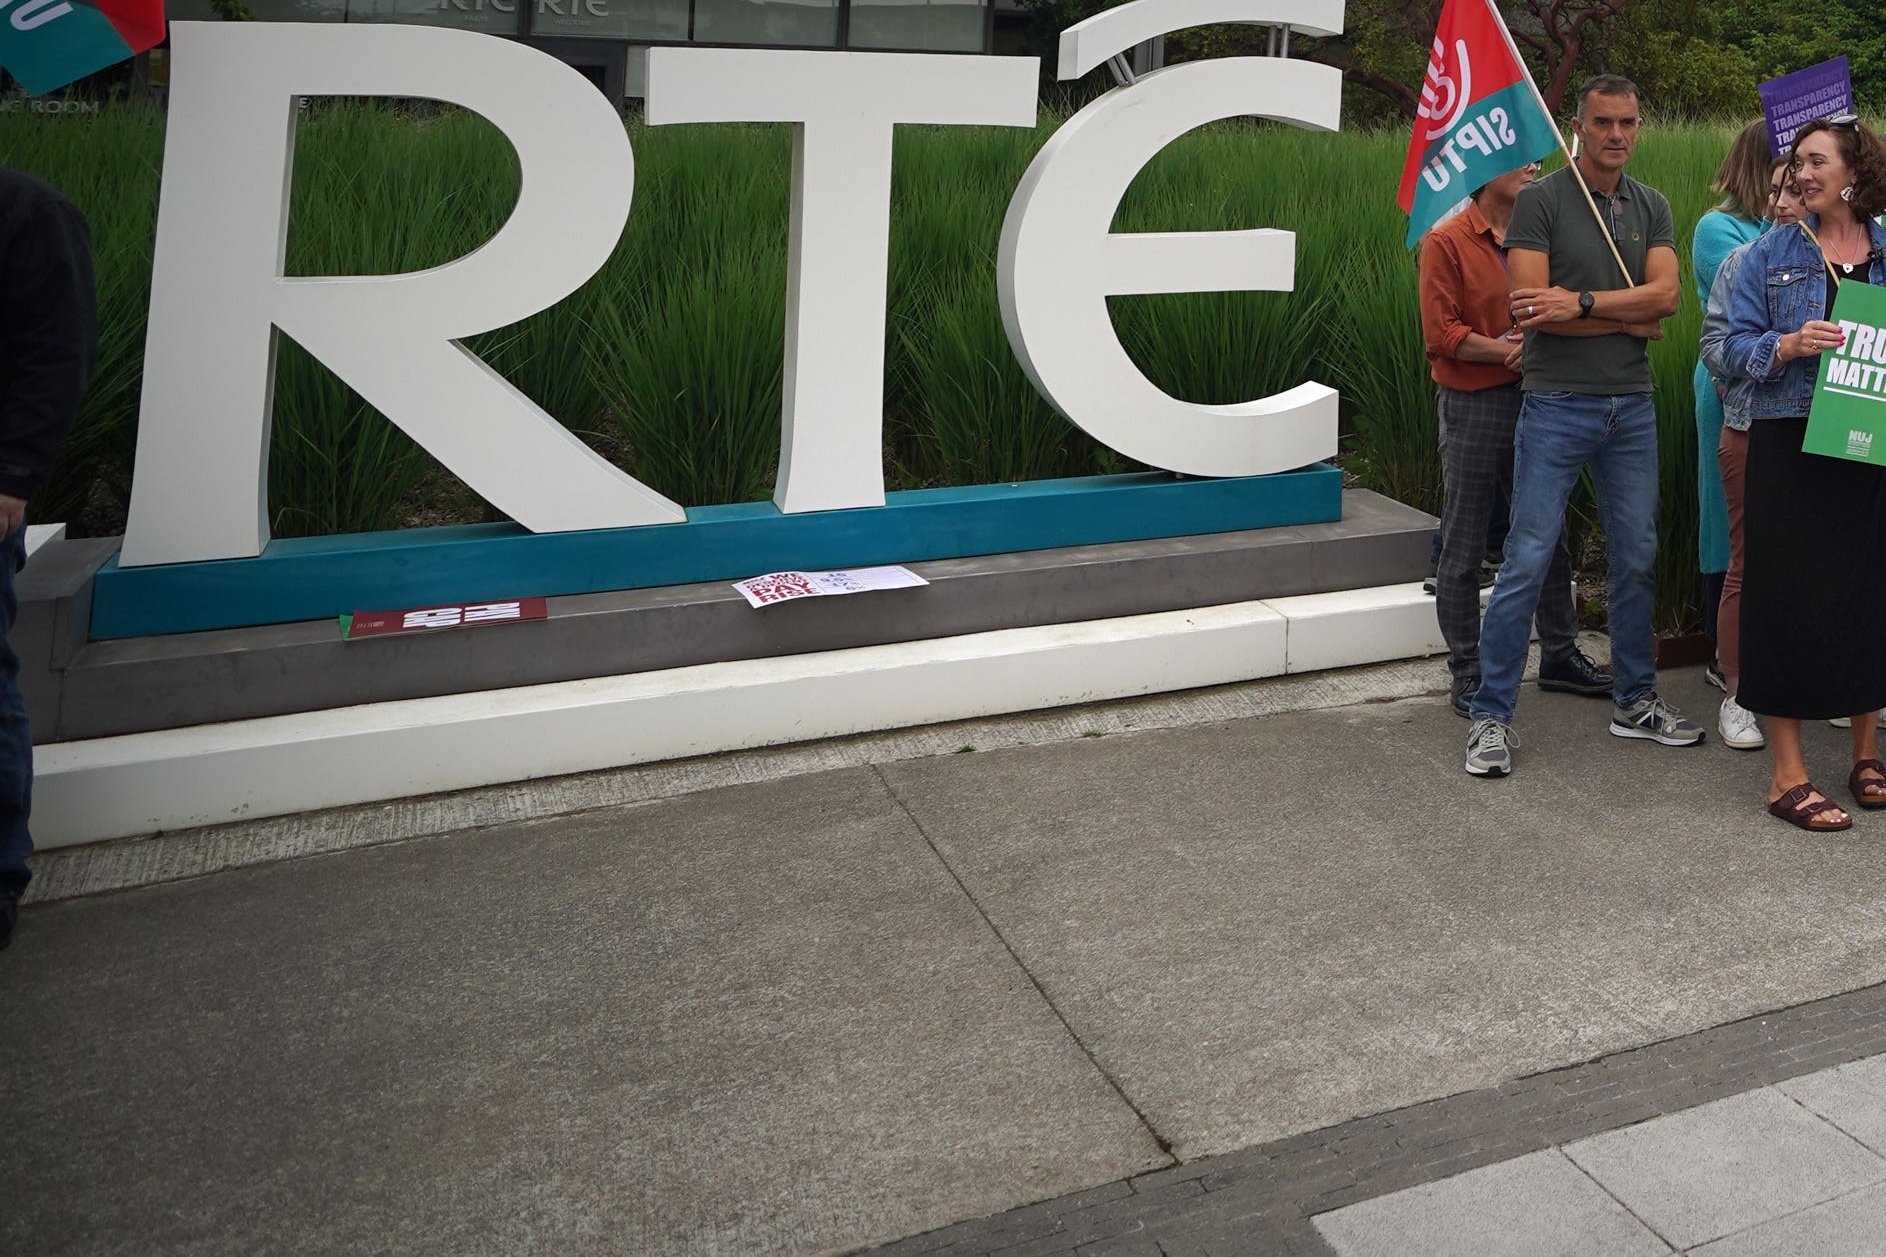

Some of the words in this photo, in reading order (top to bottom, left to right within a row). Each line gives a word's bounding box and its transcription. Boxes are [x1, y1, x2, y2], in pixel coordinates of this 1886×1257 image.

[32, 101, 99, 113] ROOM
[1771, 81, 1847, 118] TRANSPARENCY
[1773, 93, 1848, 131] TRANSPARENCY
[1848, 430, 1873, 443] NUJ
[752, 582, 810, 597] PAY
[758, 587, 819, 603] RISE
